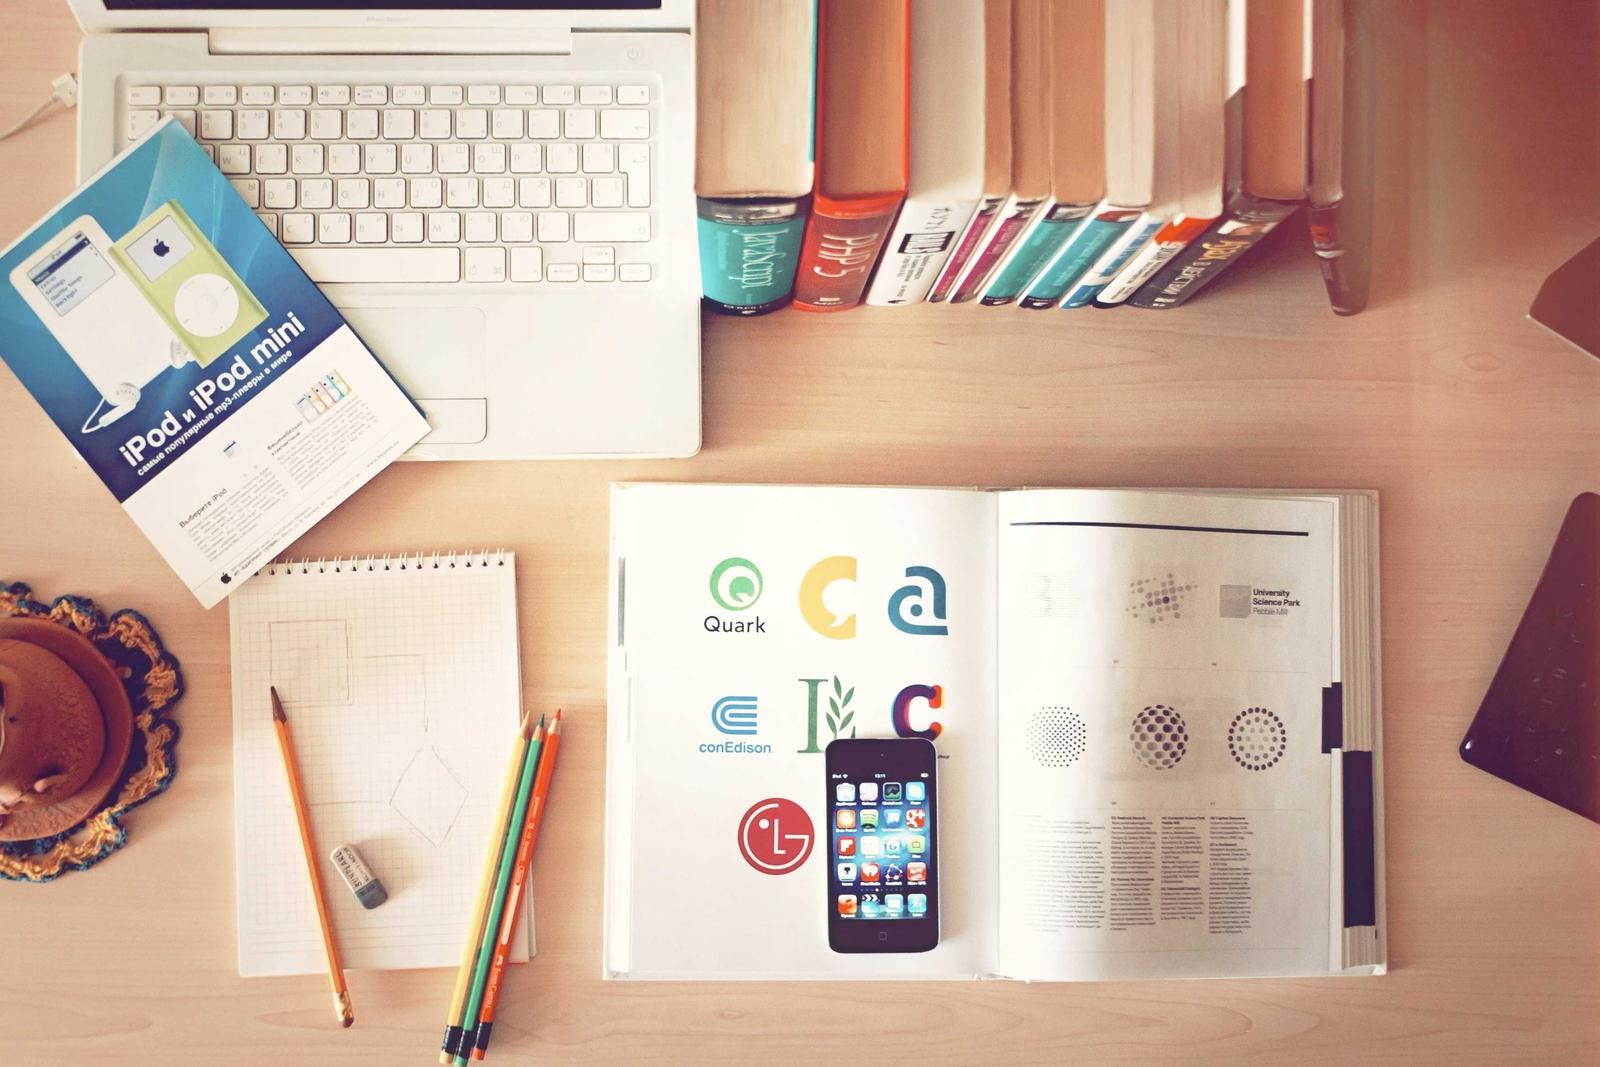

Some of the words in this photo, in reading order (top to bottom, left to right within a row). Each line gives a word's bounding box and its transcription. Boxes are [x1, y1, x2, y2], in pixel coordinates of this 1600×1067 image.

[728, 228, 790, 289] JavaScript
[818, 233, 878, 265] PHP
[813, 265, 866, 278] 5
[250, 311, 306, 366] mini
[189, 354, 252, 411] iPod
[137, 452, 165, 477] самые
[164, 411, 215, 455] популярные
[214, 373, 265, 416] mp3-плееры
[264, 367, 271, 375] в
[271, 350, 293, 371] мире
[182, 408, 197, 424] и
[119, 410, 183, 467] iPod
[179, 500, 212, 529] Выберите
[212, 488, 228, 502] iPod
[1252, 598, 1282, 606] Science
[1253, 588, 1290, 598] University
[704, 616, 766, 633] Quark
[699, 741, 772, 754] conEdison
